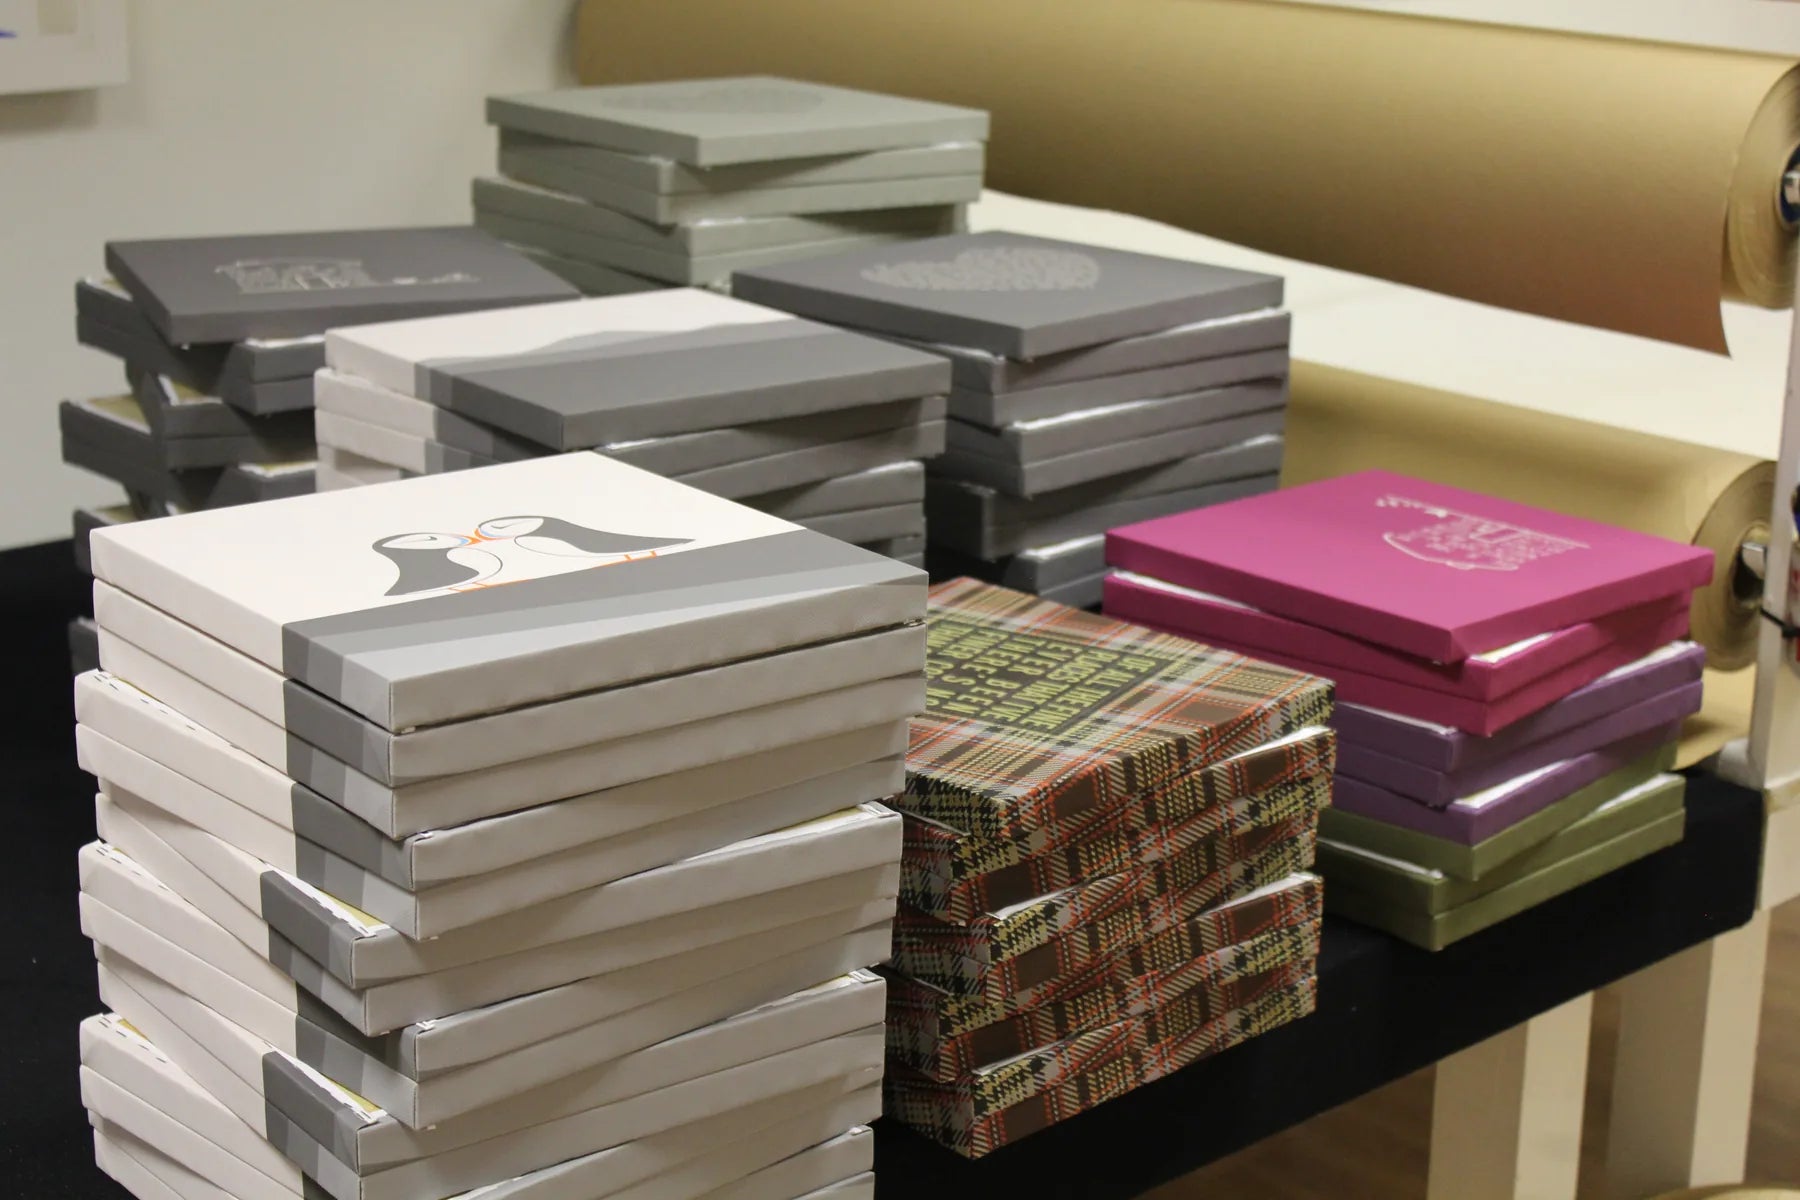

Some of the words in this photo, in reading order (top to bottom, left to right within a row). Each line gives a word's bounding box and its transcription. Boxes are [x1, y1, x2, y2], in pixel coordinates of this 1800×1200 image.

[936, 630, 1010, 659] FINER
[1005, 642, 1083, 676] EVER
[1045, 650, 1120, 683] PLACES
[1114, 656, 1159, 672] OF
[1083, 669, 1137, 687] ALL
[940, 677, 1022, 714] BEEN
[1009, 680, 1071, 704] THAT
[1053, 687, 1112, 707] THE
[978, 701, 1035, 722] I'VE
[1018, 703, 1082, 729] FINE
